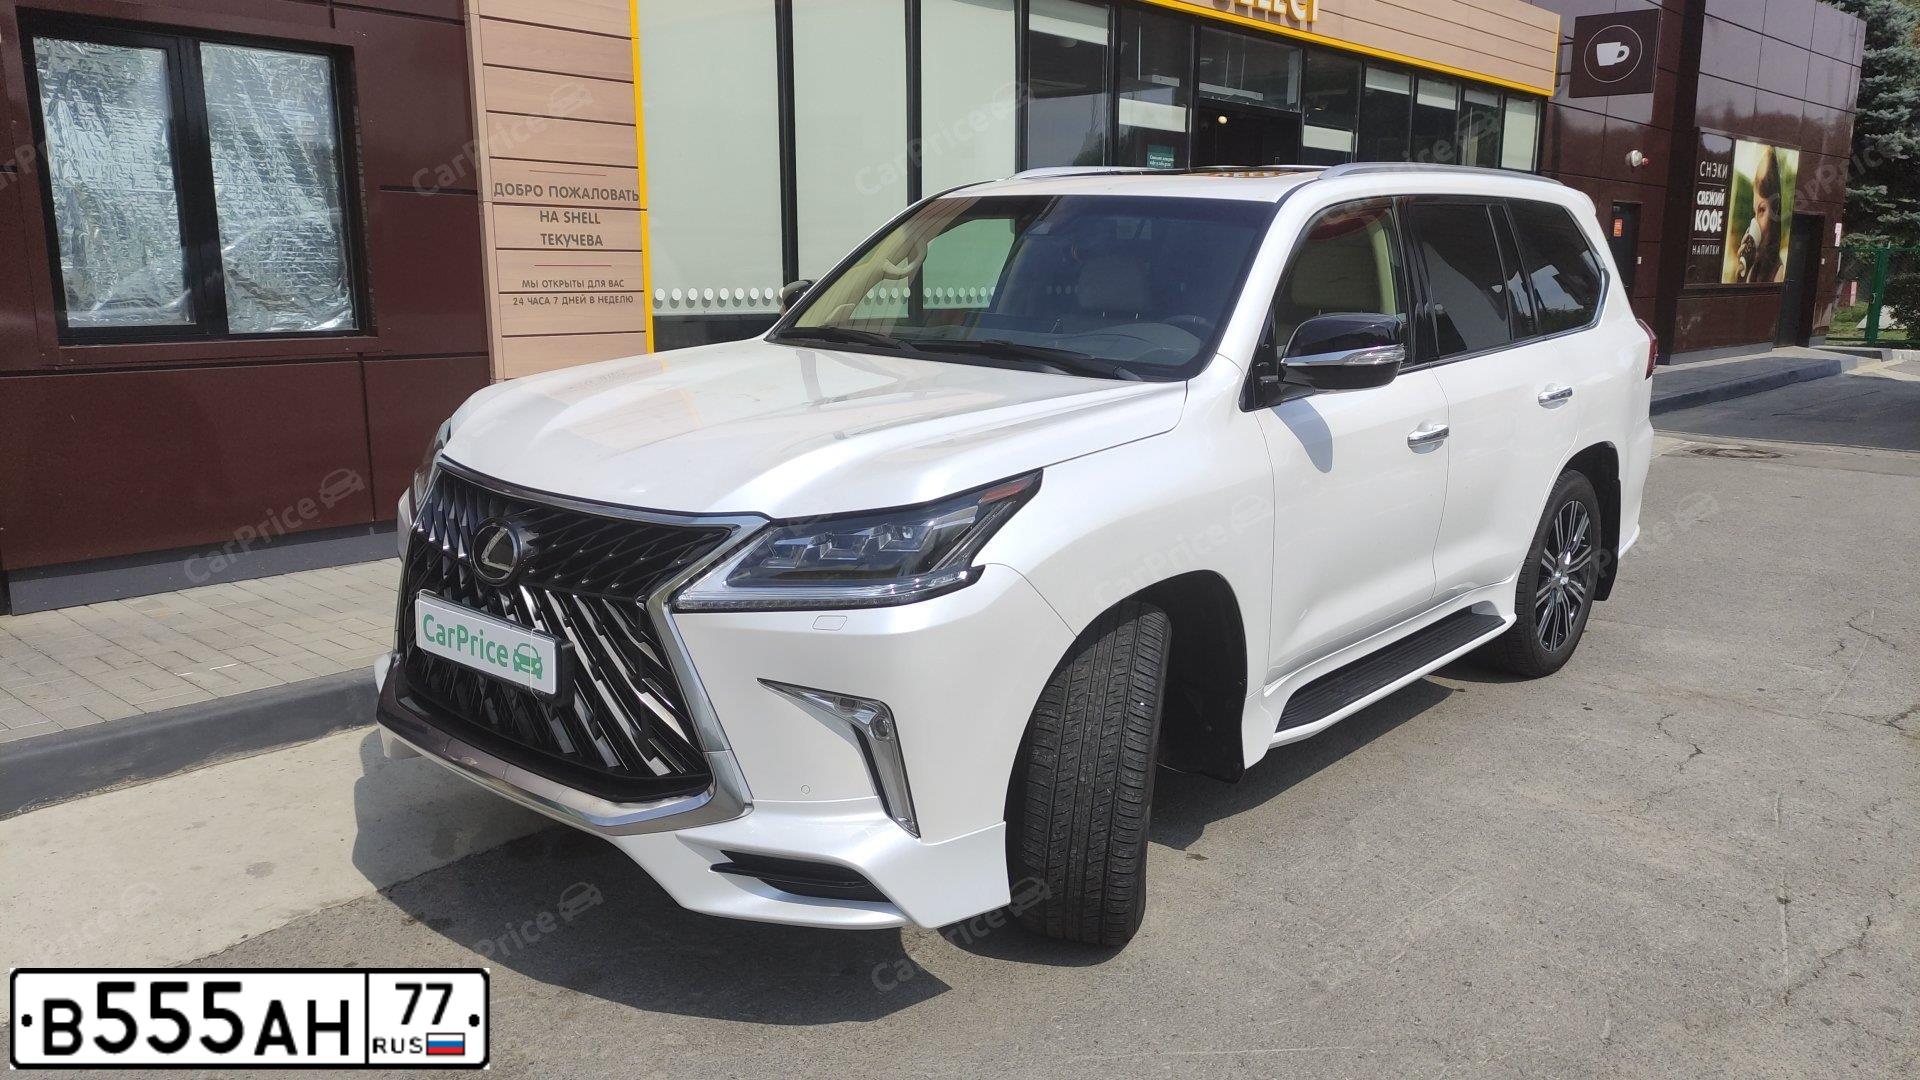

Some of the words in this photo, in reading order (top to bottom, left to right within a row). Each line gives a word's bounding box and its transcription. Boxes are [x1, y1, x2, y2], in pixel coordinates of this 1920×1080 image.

[1700, 161, 1728, 179] СНЭКИ
[494, 182, 543, 197] ДОБРО
[549, 186, 639, 201] ПОЖАЛОВАТЬ
[1697, 189, 1725, 206] СВЕЖИЙ
[539, 210, 559, 223] НА
[563, 211, 601, 224] SHELL
[1694, 209, 1723, 233] КОФЕ
[540, 233, 603, 247] ТЕКУЧЕВА
[1692, 244, 1720, 255] НАПИТКИ
[522, 280, 539, 288] МЫ
[542, 280, 585, 288] ОТКРЫТЫ
[587, 280, 606, 289] ДЛЯ
[608, 280, 625, 288] ВАС
[513, 297, 524, 306] 24
[527, 297, 550, 305] ЧАСА
[562, 294, 587, 305] ДНЕЙ
[589, 296, 595, 304] В
[597, 295, 634, 305] НЕДЕЛЮ
[423, 613, 508, 668] CarPrice
